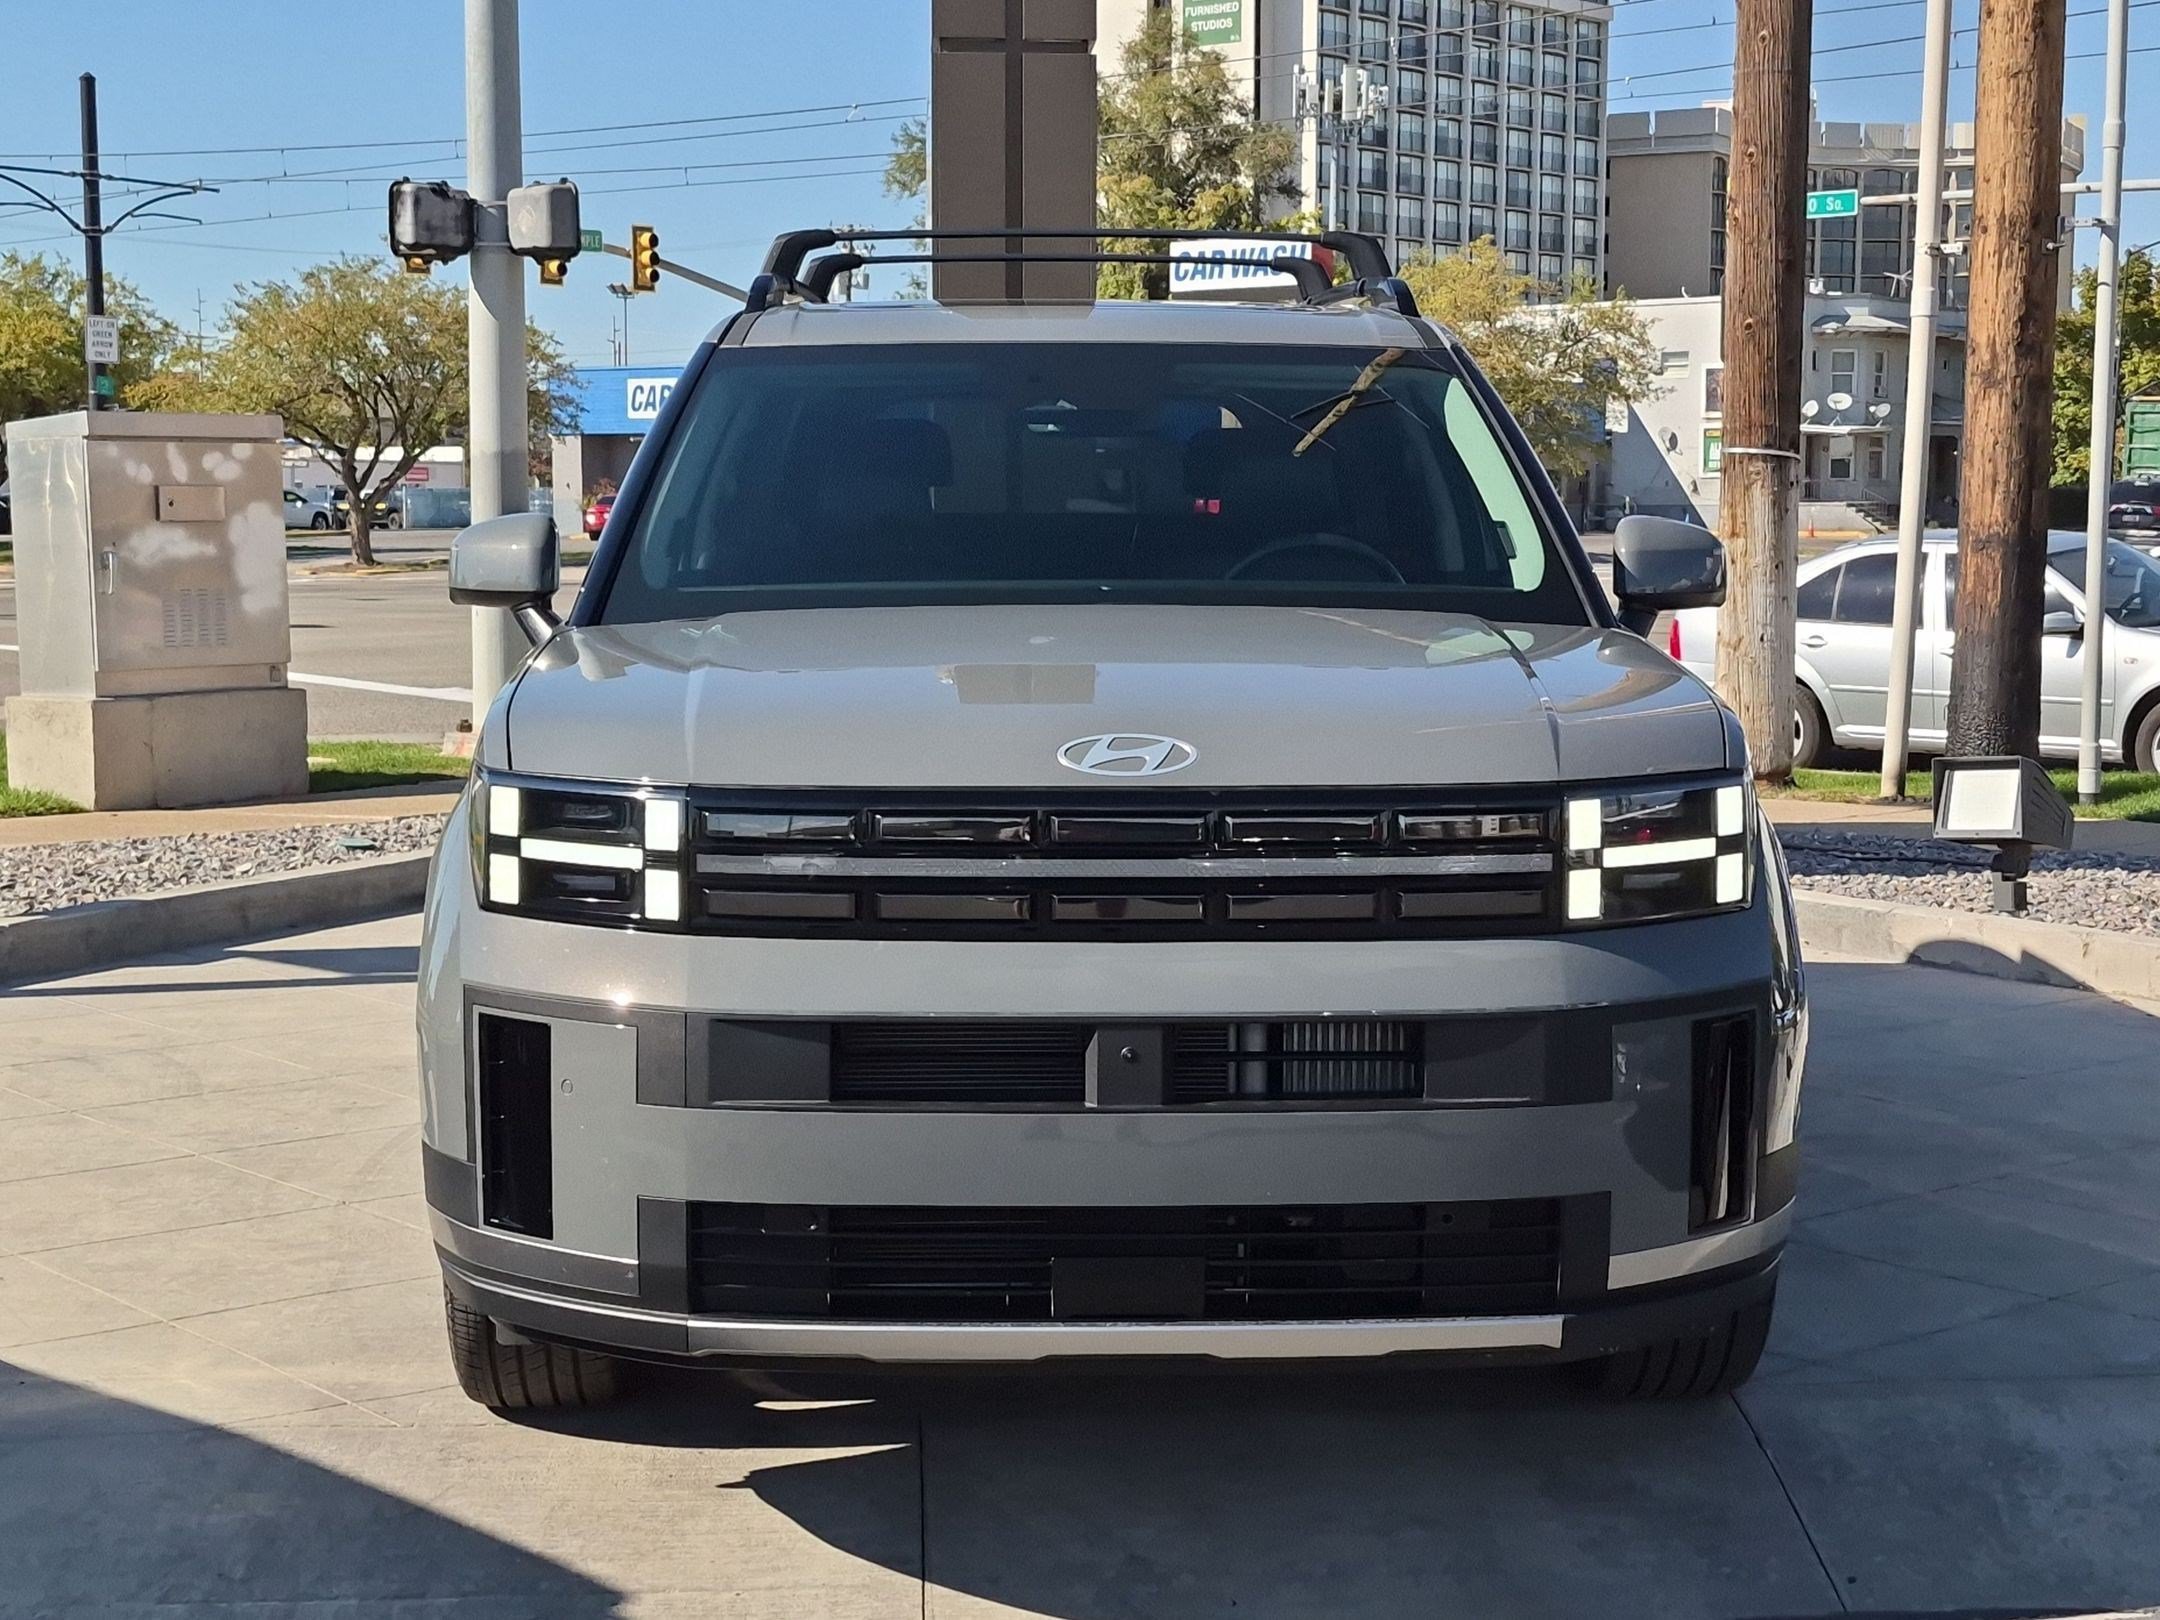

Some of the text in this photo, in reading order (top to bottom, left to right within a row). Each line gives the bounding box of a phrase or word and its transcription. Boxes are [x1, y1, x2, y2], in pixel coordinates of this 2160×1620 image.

[1185, 2, 1239, 17] FURNISHED
[1191, 18, 1233, 32] STUDIOS
[1175, 249, 1225, 281] CAR
[90, 320, 104, 329] LEFT
[92, 341, 113, 349] ARROW
[95, 351, 111, 359] ONLY
